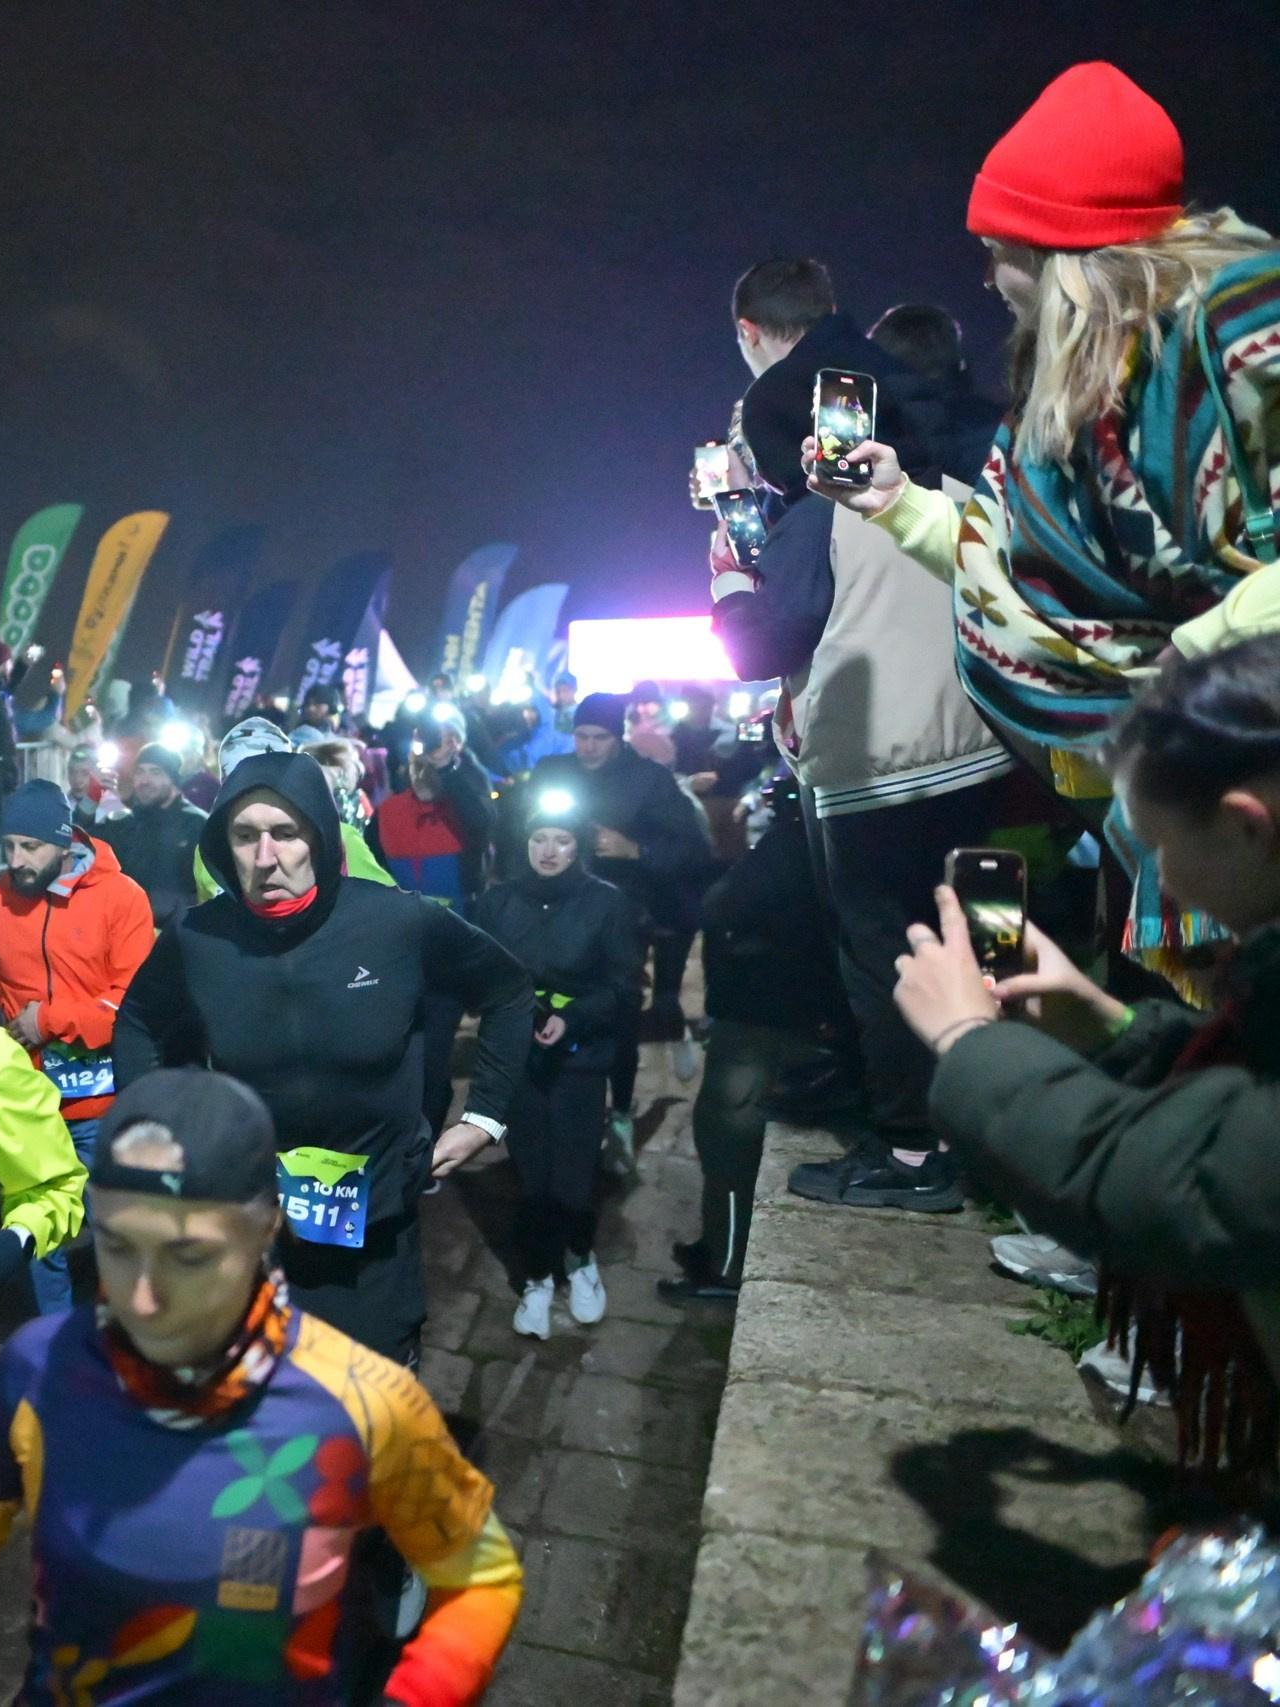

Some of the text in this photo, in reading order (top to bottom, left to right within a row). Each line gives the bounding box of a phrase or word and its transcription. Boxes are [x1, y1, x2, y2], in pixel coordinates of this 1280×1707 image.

[181, 629, 204, 678] WILD
[195, 630, 223, 681] TRAIL
[347, 978, 380, 989] DEMIX
[58, 1068, 110, 1089] 1124
[313, 1181, 359, 1199] 10 KM
